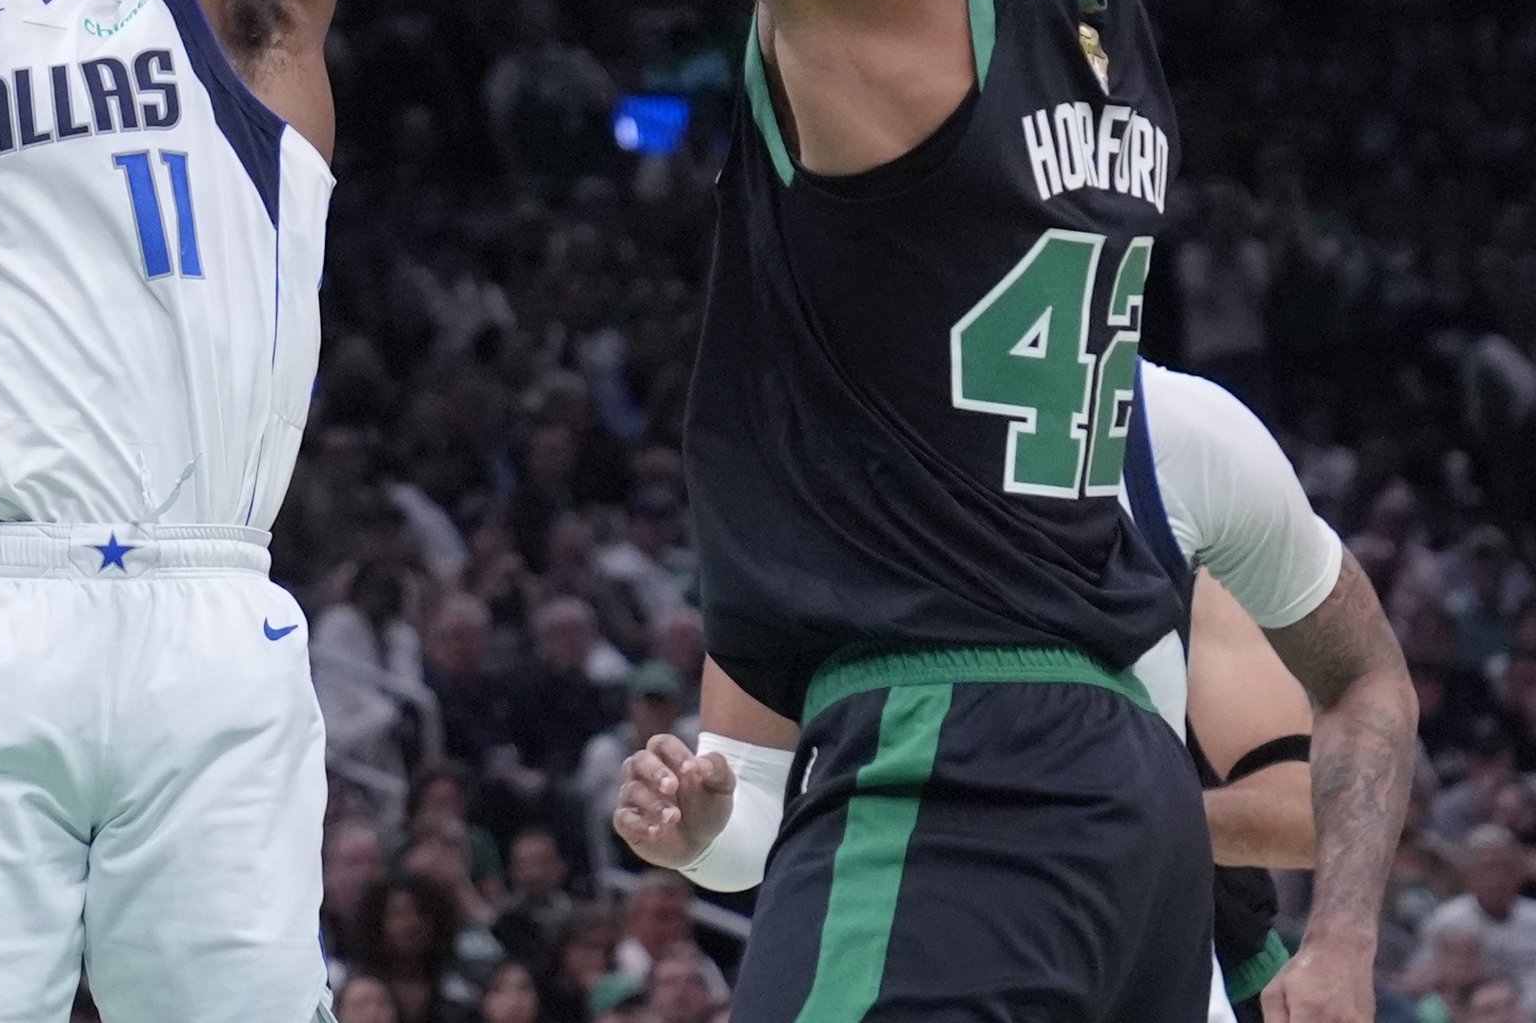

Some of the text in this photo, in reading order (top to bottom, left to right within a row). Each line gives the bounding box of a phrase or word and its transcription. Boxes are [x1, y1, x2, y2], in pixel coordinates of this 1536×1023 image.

[111, 148, 206, 282] 11
[1021, 101, 1170, 214] HORFORD
[950, 228, 1154, 500] 42
